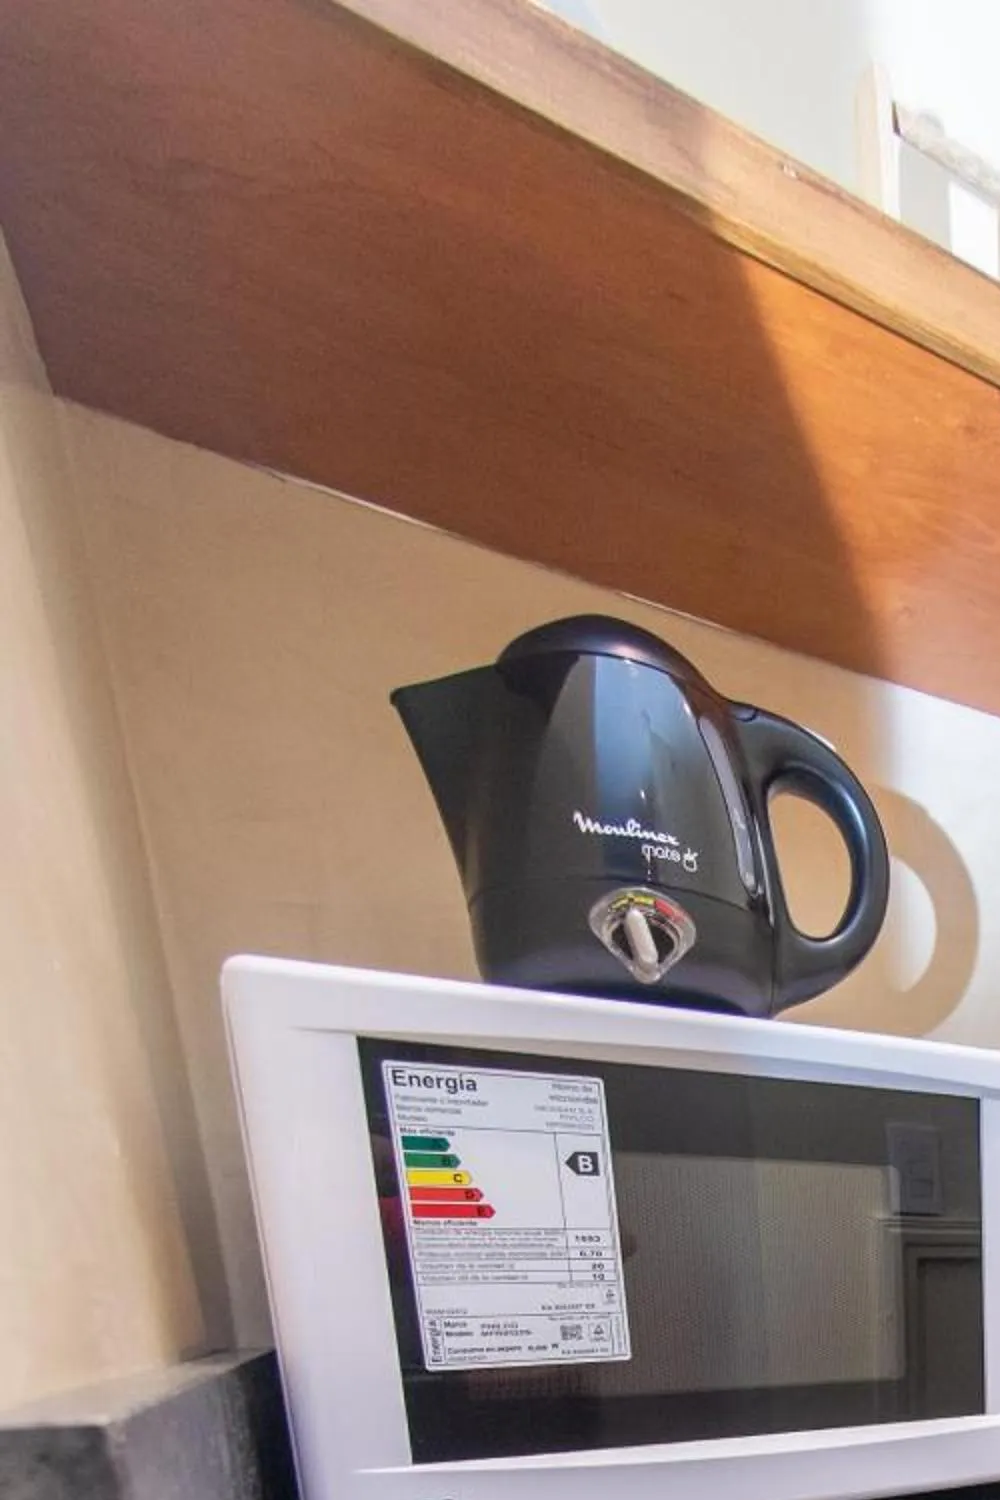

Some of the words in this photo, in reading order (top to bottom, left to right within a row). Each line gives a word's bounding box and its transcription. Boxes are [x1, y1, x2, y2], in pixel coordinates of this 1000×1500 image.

[573, 810, 680, 846] Moulinex
[578, 1155, 594, 1173] B
[453, 1173, 463, 1183] C
